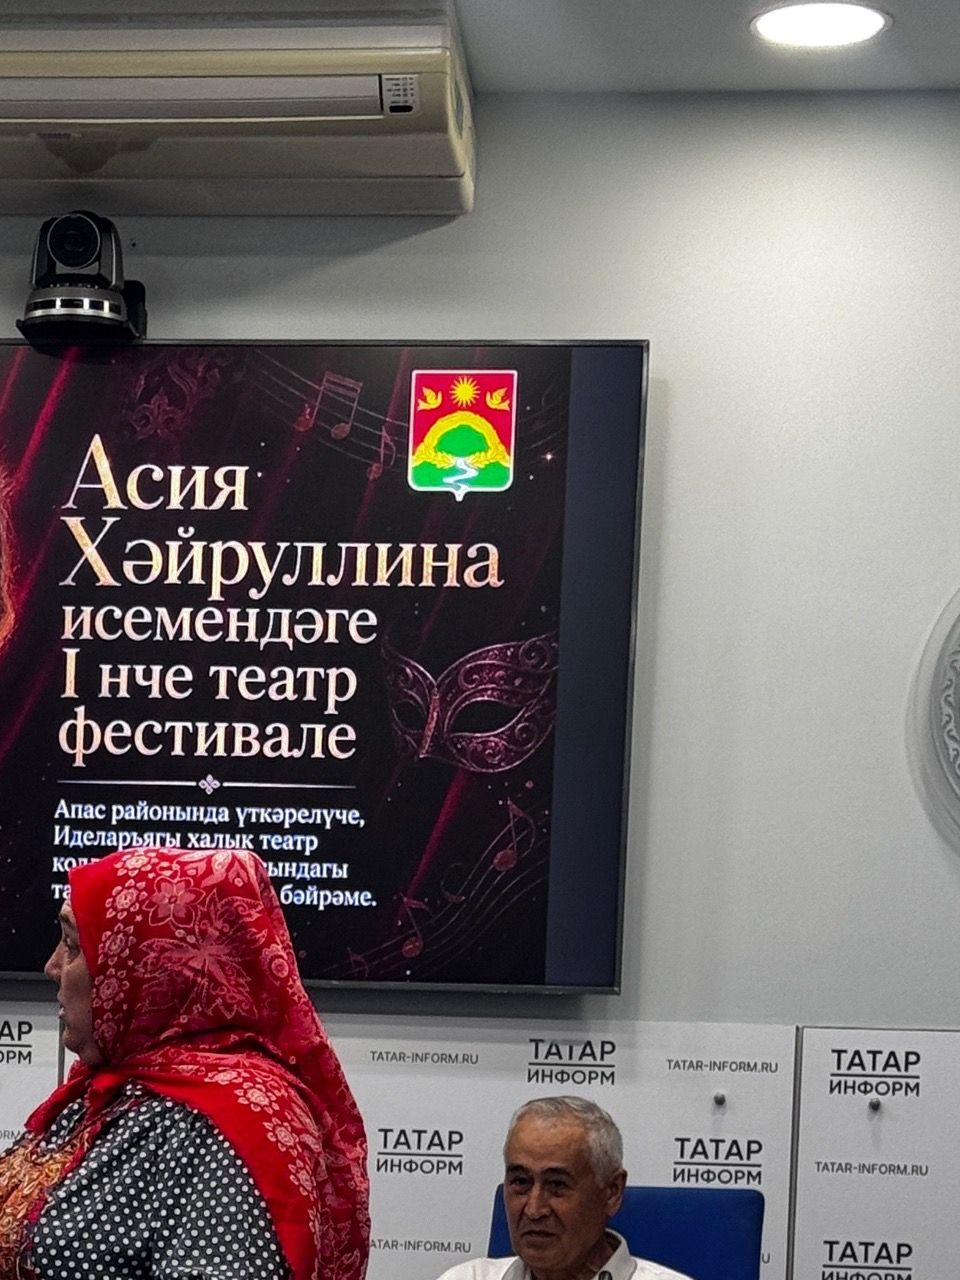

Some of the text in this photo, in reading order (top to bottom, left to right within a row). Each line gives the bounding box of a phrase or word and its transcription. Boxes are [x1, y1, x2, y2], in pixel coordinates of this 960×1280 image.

[61, 434, 249, 511] Асия
[59, 516, 504, 601] Хәйруллина
[61, 604, 378, 650] исемендәге
[98, 662, 194, 700] нче
[209, 664, 358, 714] театр
[58, 705, 358, 767] фестивале
[54, 799, 366, 829] Апас районында үткәрелүче,
[187, 832, 254, 849] халык
[259, 832, 318, 855] театр
[264, 861, 349, 880] ындагы
[280, 883, 377, 911] бәйрәме.
[370, 1050, 479, 1065] TATAR-INFORM.RU
[529, 1038, 616, 1062] ТАТАР
[831, 1049, 921, 1072] ТАТАР
[527, 1068, 616, 1085] ИНФОРМ
[666, 1059, 778, 1073] TATAR-INFORM.RU
[829, 1079, 920, 1097] ИНФОРМ
[378, 1128, 464, 1151] ТАТАР
[674, 1138, 763, 1161] ТАТАР
[376, 1158, 463, 1175] ИНФОРМ
[672, 1167, 762, 1185] ИНФОРМ
[815, 1161, 929, 1176] TATAR-INFORM.RU
[370, 1239, 472, 1253] ATAR-INFORM.RU
[823, 1240, 913, 1264] ТАТАР
